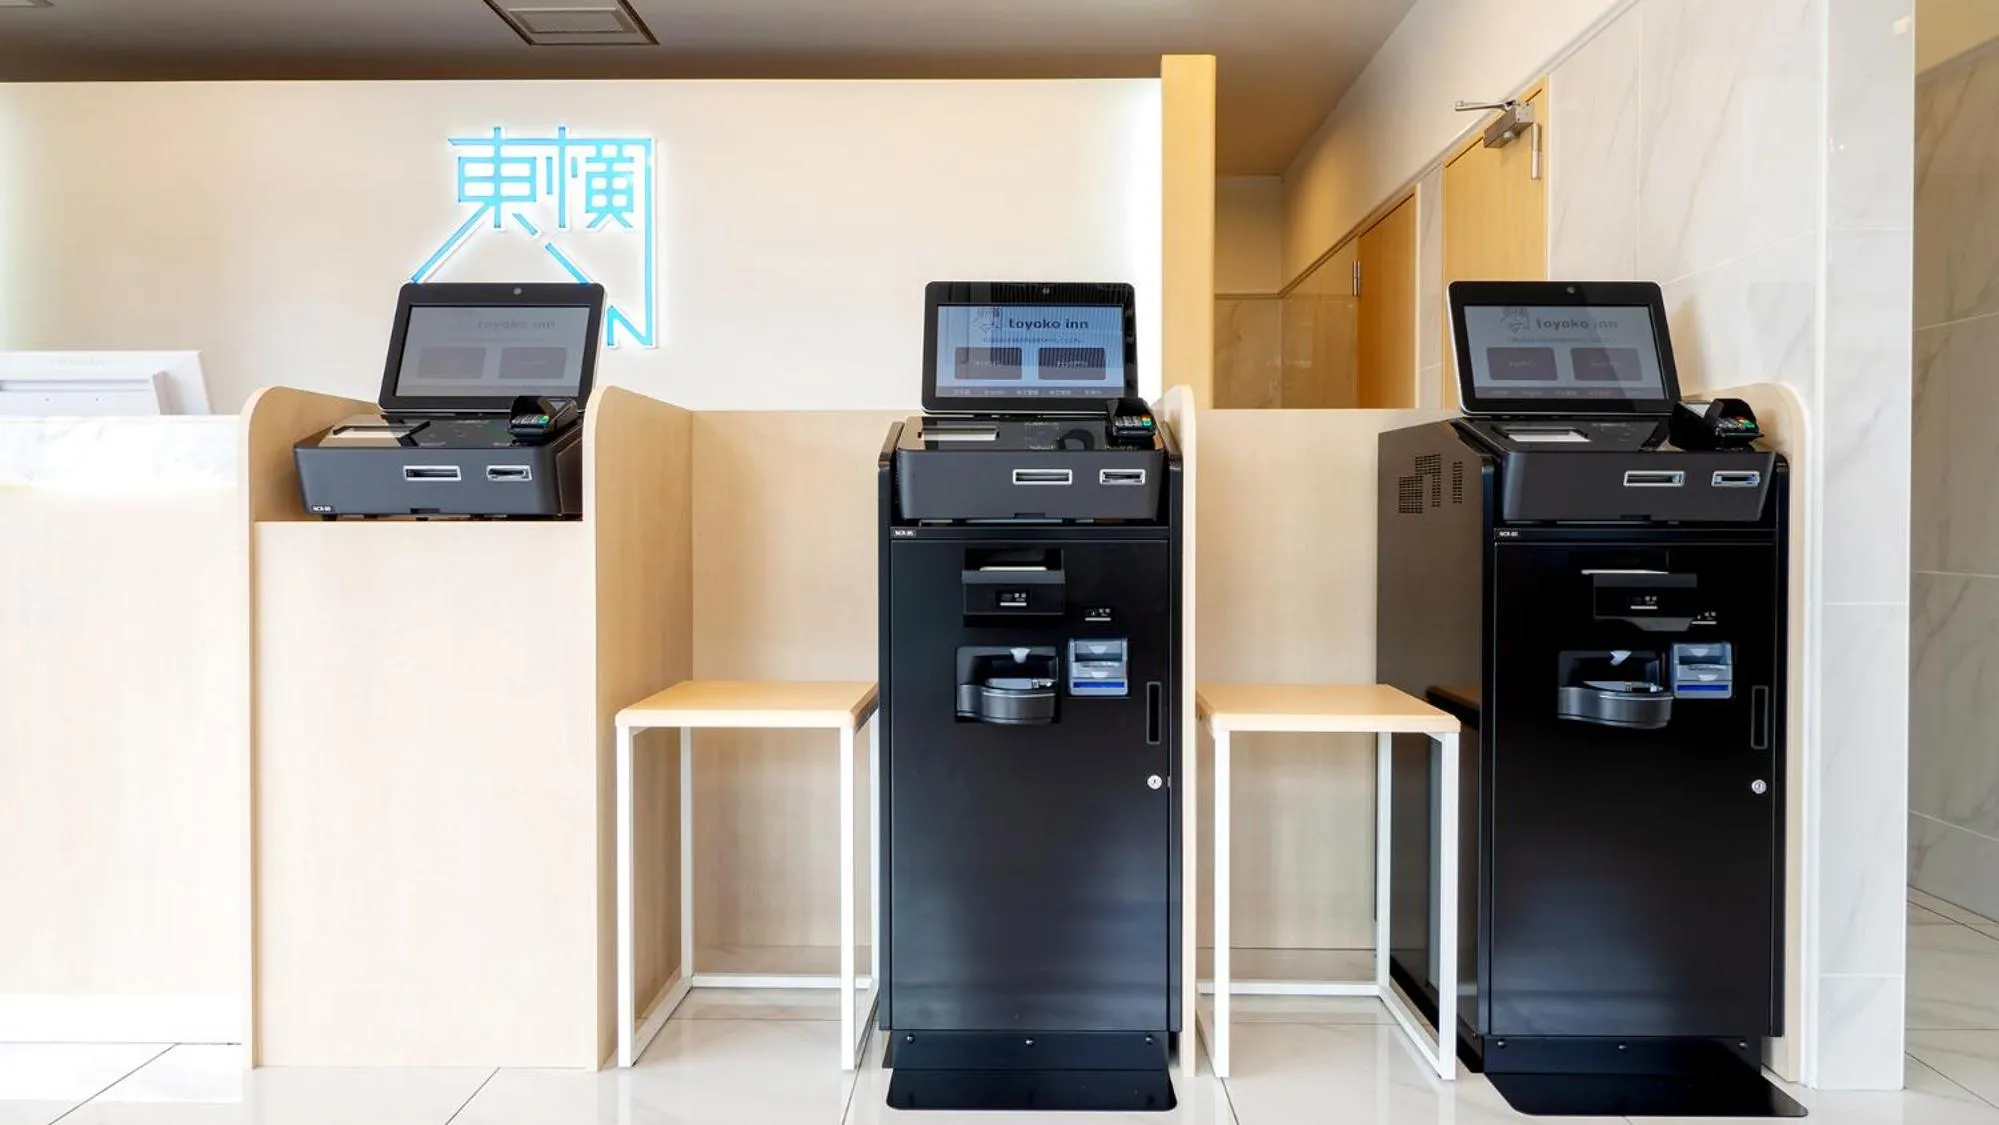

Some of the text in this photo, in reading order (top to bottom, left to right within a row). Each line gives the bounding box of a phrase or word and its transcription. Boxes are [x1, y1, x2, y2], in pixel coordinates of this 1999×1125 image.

[447, 126, 652, 230] 東横
[1009, 318, 1062, 332] toyoko
[1065, 318, 1089, 329] inn
[1536, 318, 1590, 331] toyoko
